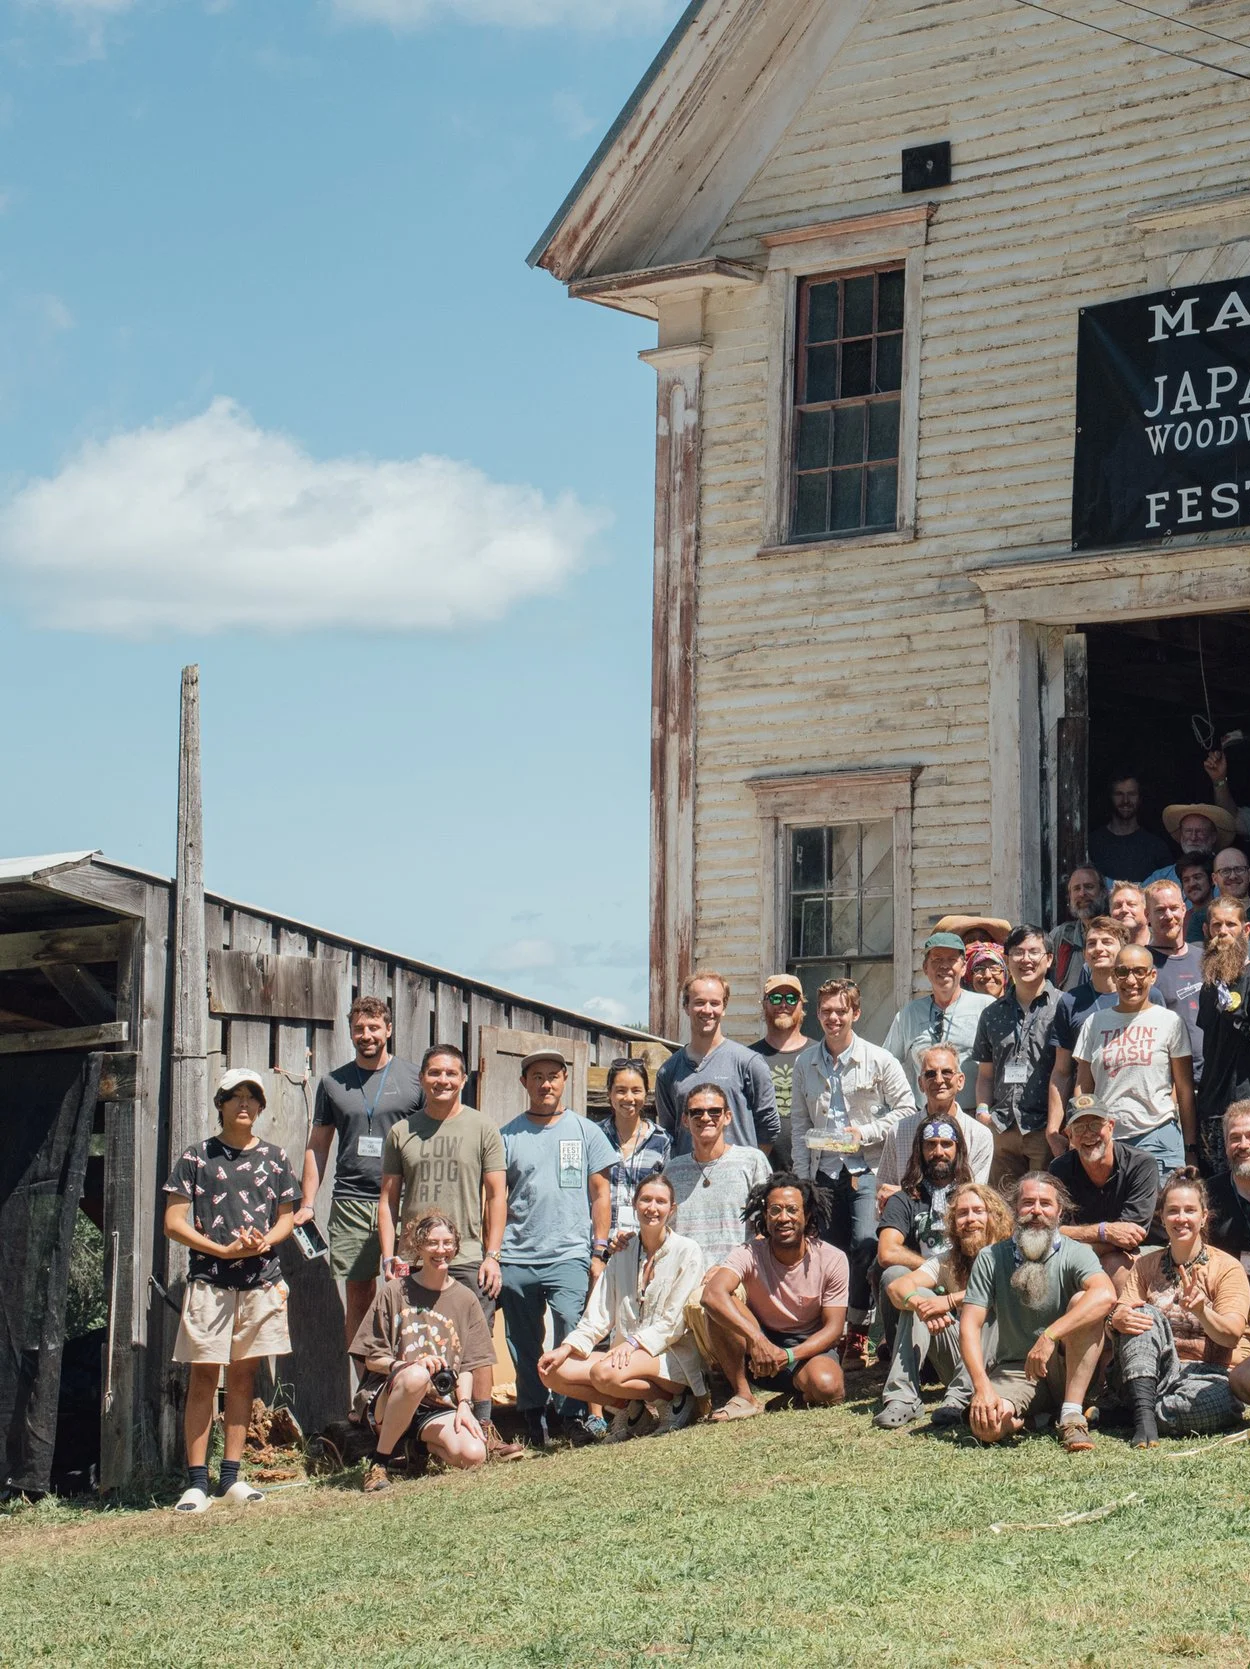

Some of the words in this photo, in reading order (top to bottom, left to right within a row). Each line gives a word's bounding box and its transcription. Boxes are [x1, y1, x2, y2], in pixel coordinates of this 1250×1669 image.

[1139, 1038, 1156, 1050] IT
[1103, 1045, 1153, 1073] EASY
[420, 1136, 463, 1158] COW
[562, 1146, 580, 1154] FEST
[420, 1160, 459, 1182] DOG
[420, 1184, 442, 1202] AF
